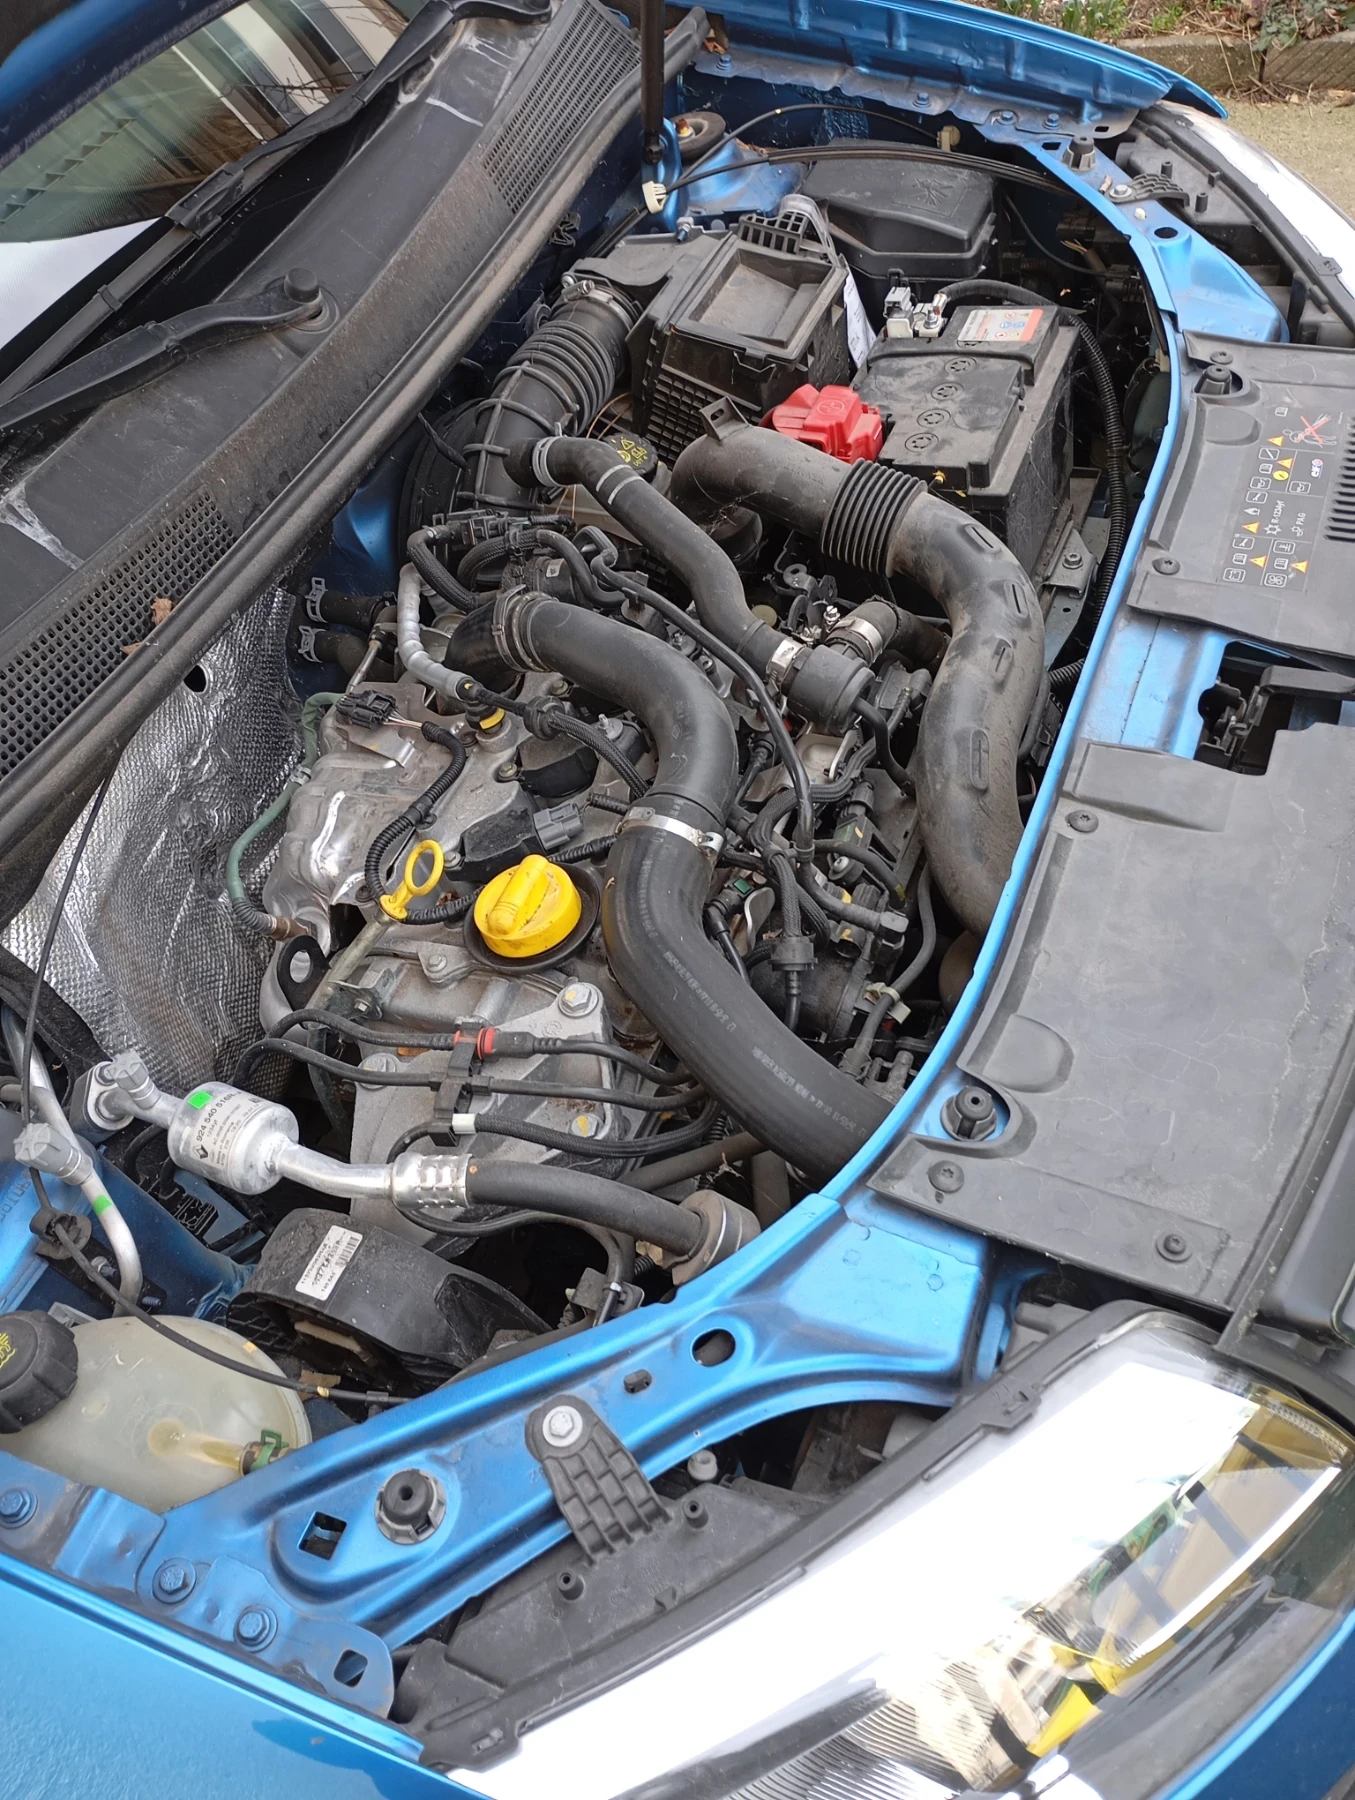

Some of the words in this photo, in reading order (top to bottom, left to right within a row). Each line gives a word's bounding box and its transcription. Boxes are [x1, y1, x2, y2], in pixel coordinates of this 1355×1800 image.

[1295, 512, 1306, 526] PAG
[196, 1124, 207, 1142] 924
[204, 1108, 218, 1124] 540
[207, 1119, 218, 1138] 1234yf
